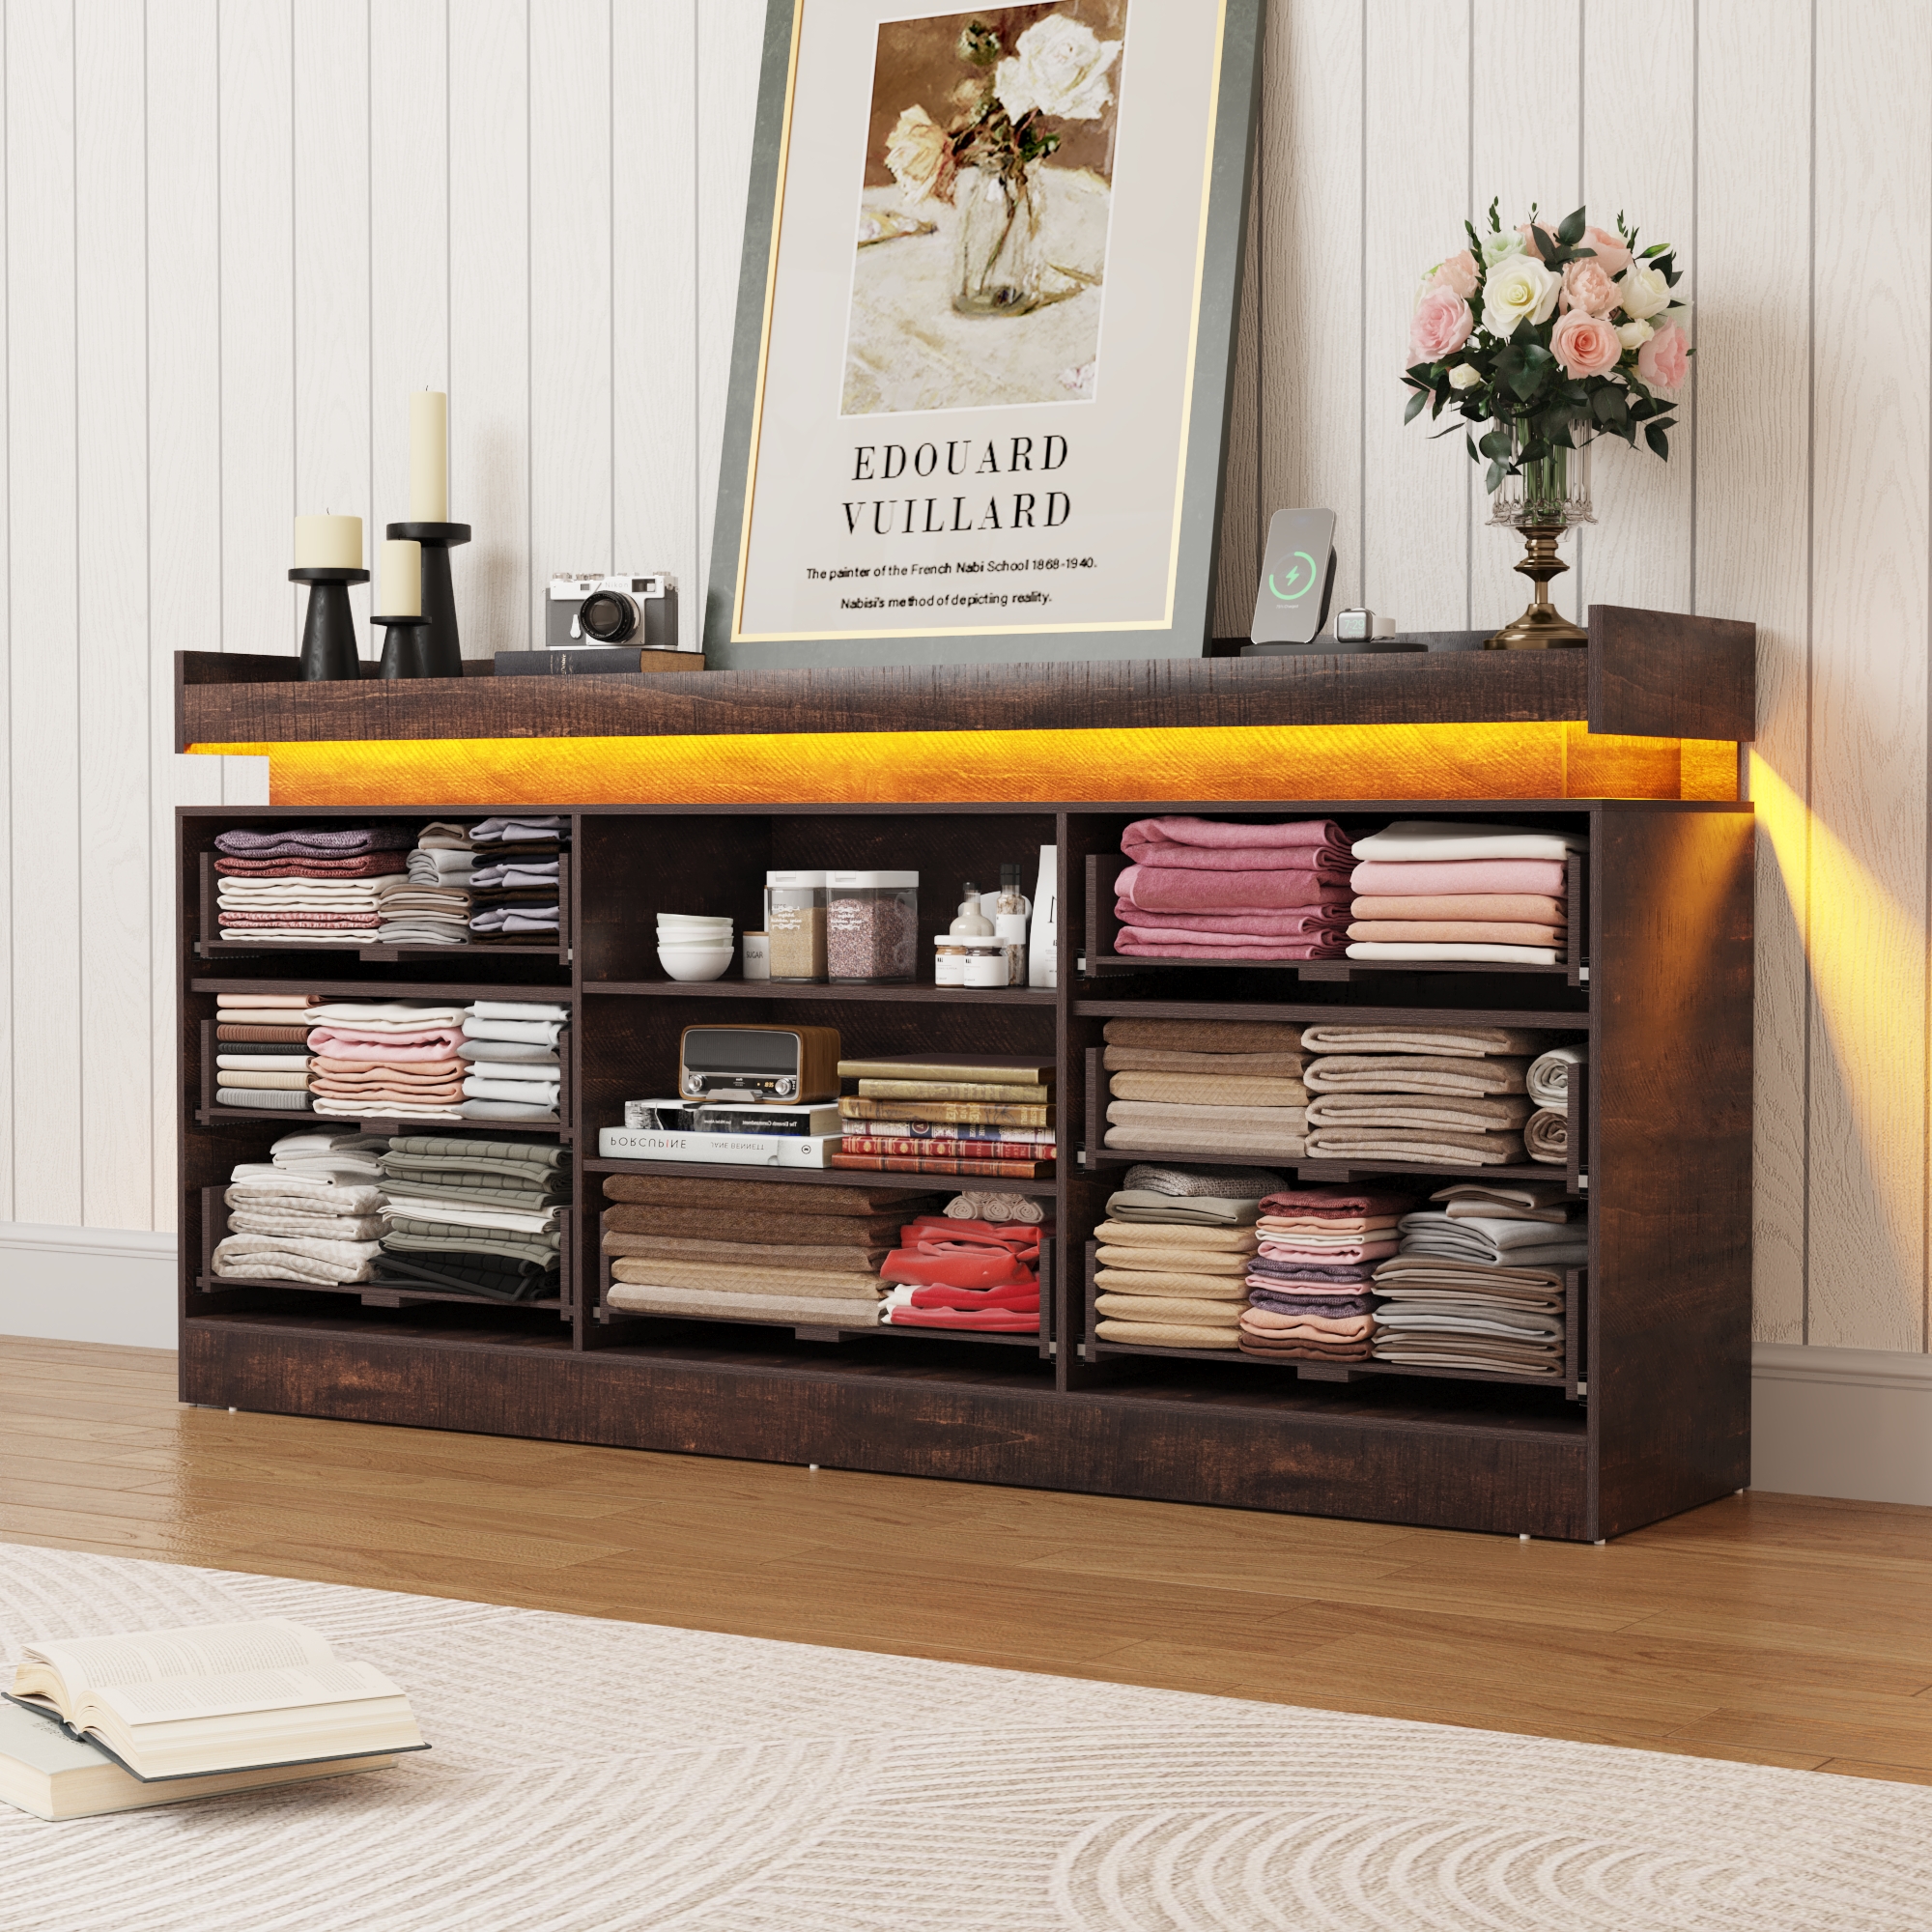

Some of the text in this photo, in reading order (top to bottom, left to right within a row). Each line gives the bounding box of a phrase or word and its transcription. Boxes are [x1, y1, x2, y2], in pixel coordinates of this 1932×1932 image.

[851, 434, 1068, 481] EDOUARD
[841, 492, 1071, 535] VUILLARD
[806, 568, 827, 580] The
[829, 567, 870, 582] painter
[873, 565, 886, 577] of
[888, 565, 907, 577] the
[911, 562, 952, 576] French
[956, 560, 984, 574] Nabi
[987, 559, 1029, 572] School
[840, 590, 1052, 610] Nabisi's method of depicting reality.
[1344, 619, 1365, 630] 7:29
